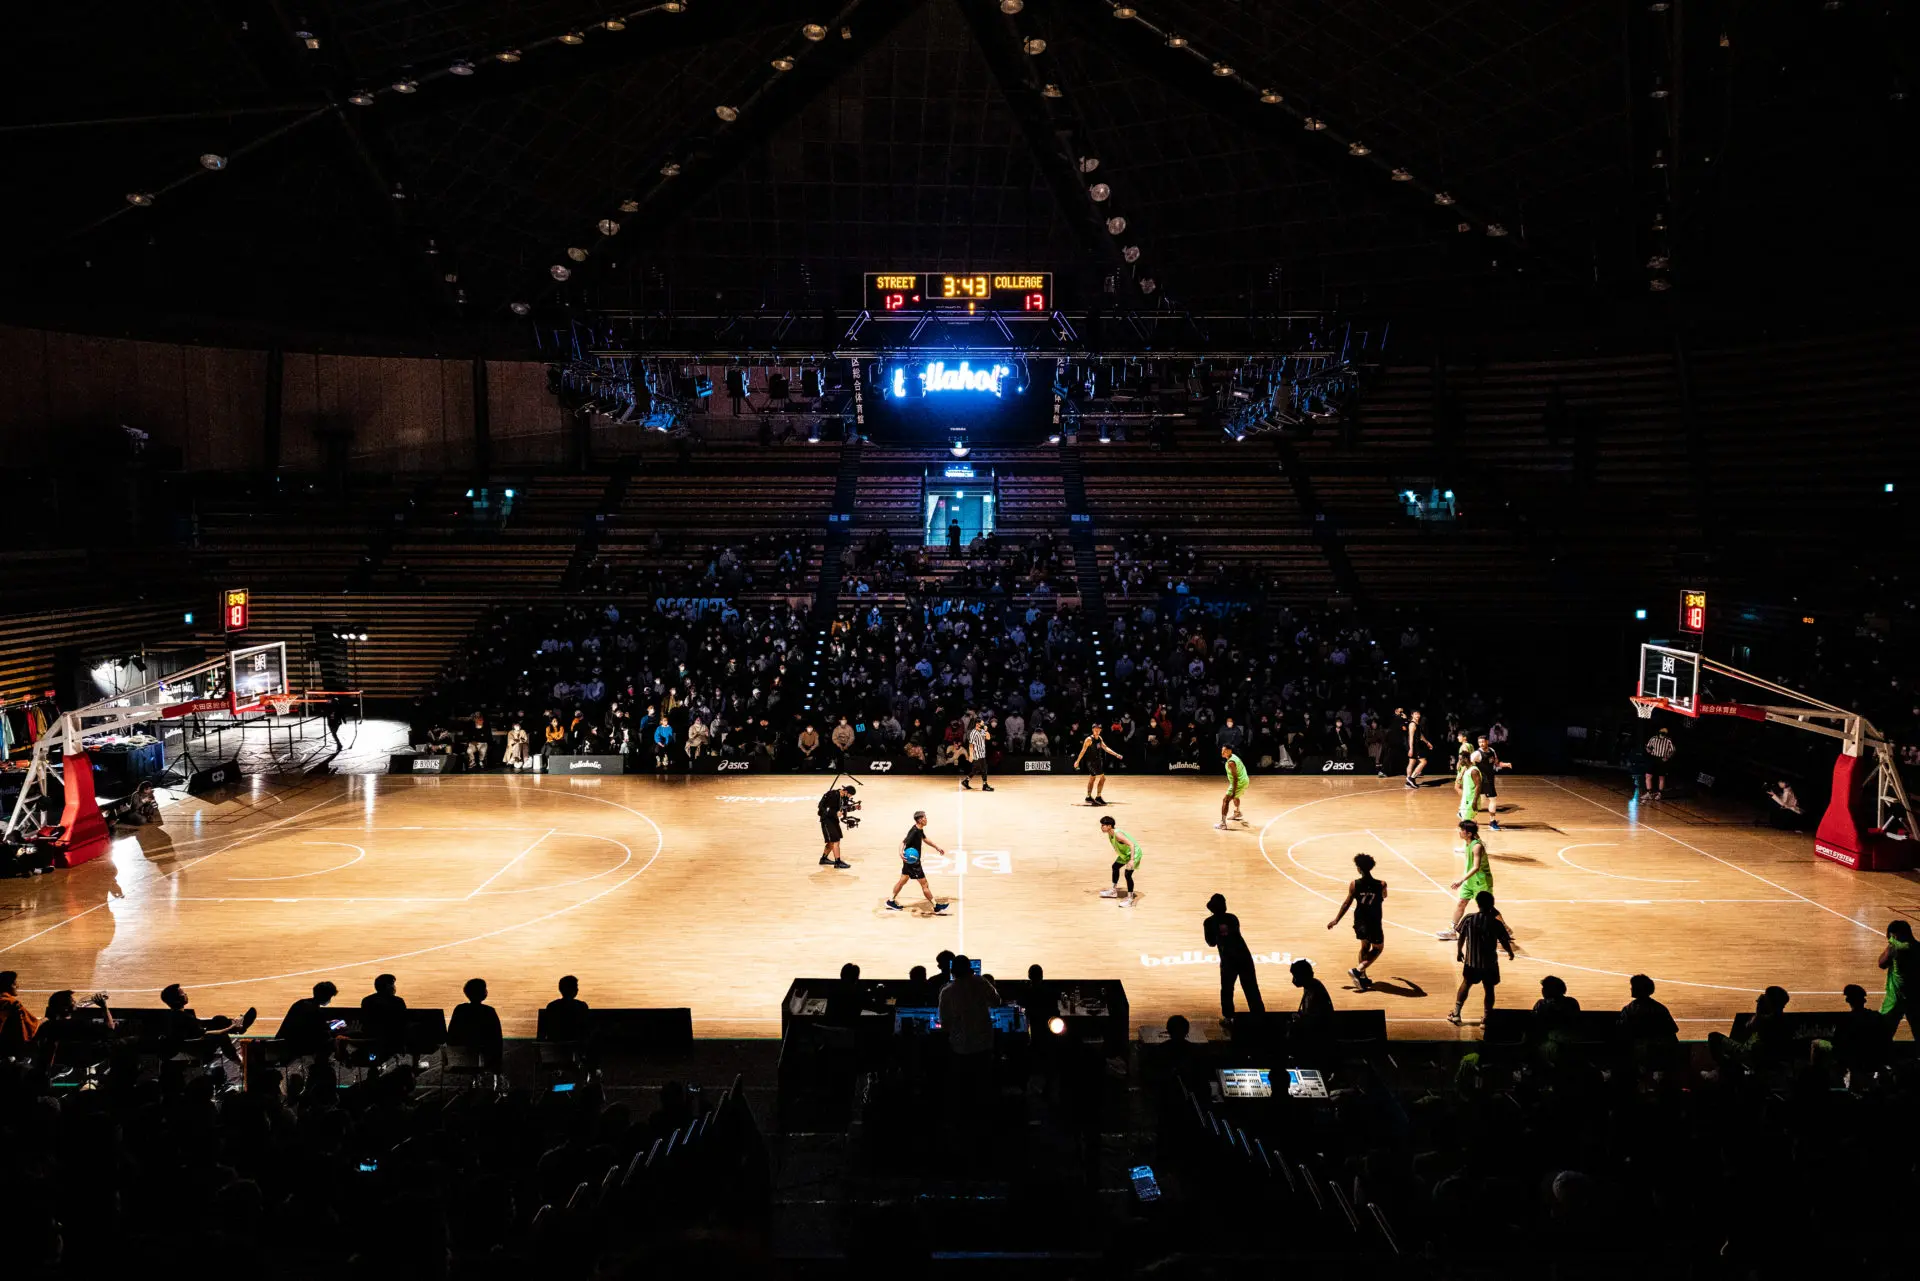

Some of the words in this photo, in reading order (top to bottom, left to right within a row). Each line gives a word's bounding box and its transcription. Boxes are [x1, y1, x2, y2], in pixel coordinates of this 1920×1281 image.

[877, 276, 916, 289] STREET
[944, 277, 986, 296] 3:43
[995, 276, 1043, 289] COLLEAGE
[192, 701, 230, 711] 大田区総合
[1700, 705, 1737, 714] 総合体育館
[570, 760, 602, 770] ballaholic
[728, 761, 749, 769] asics
[1169, 761, 1200, 770] ballaholic
[1333, 762, 1354, 770] asics
[1359, 892, 1376, 904] 77
[1140, 951, 1316, 966] ballaoli
